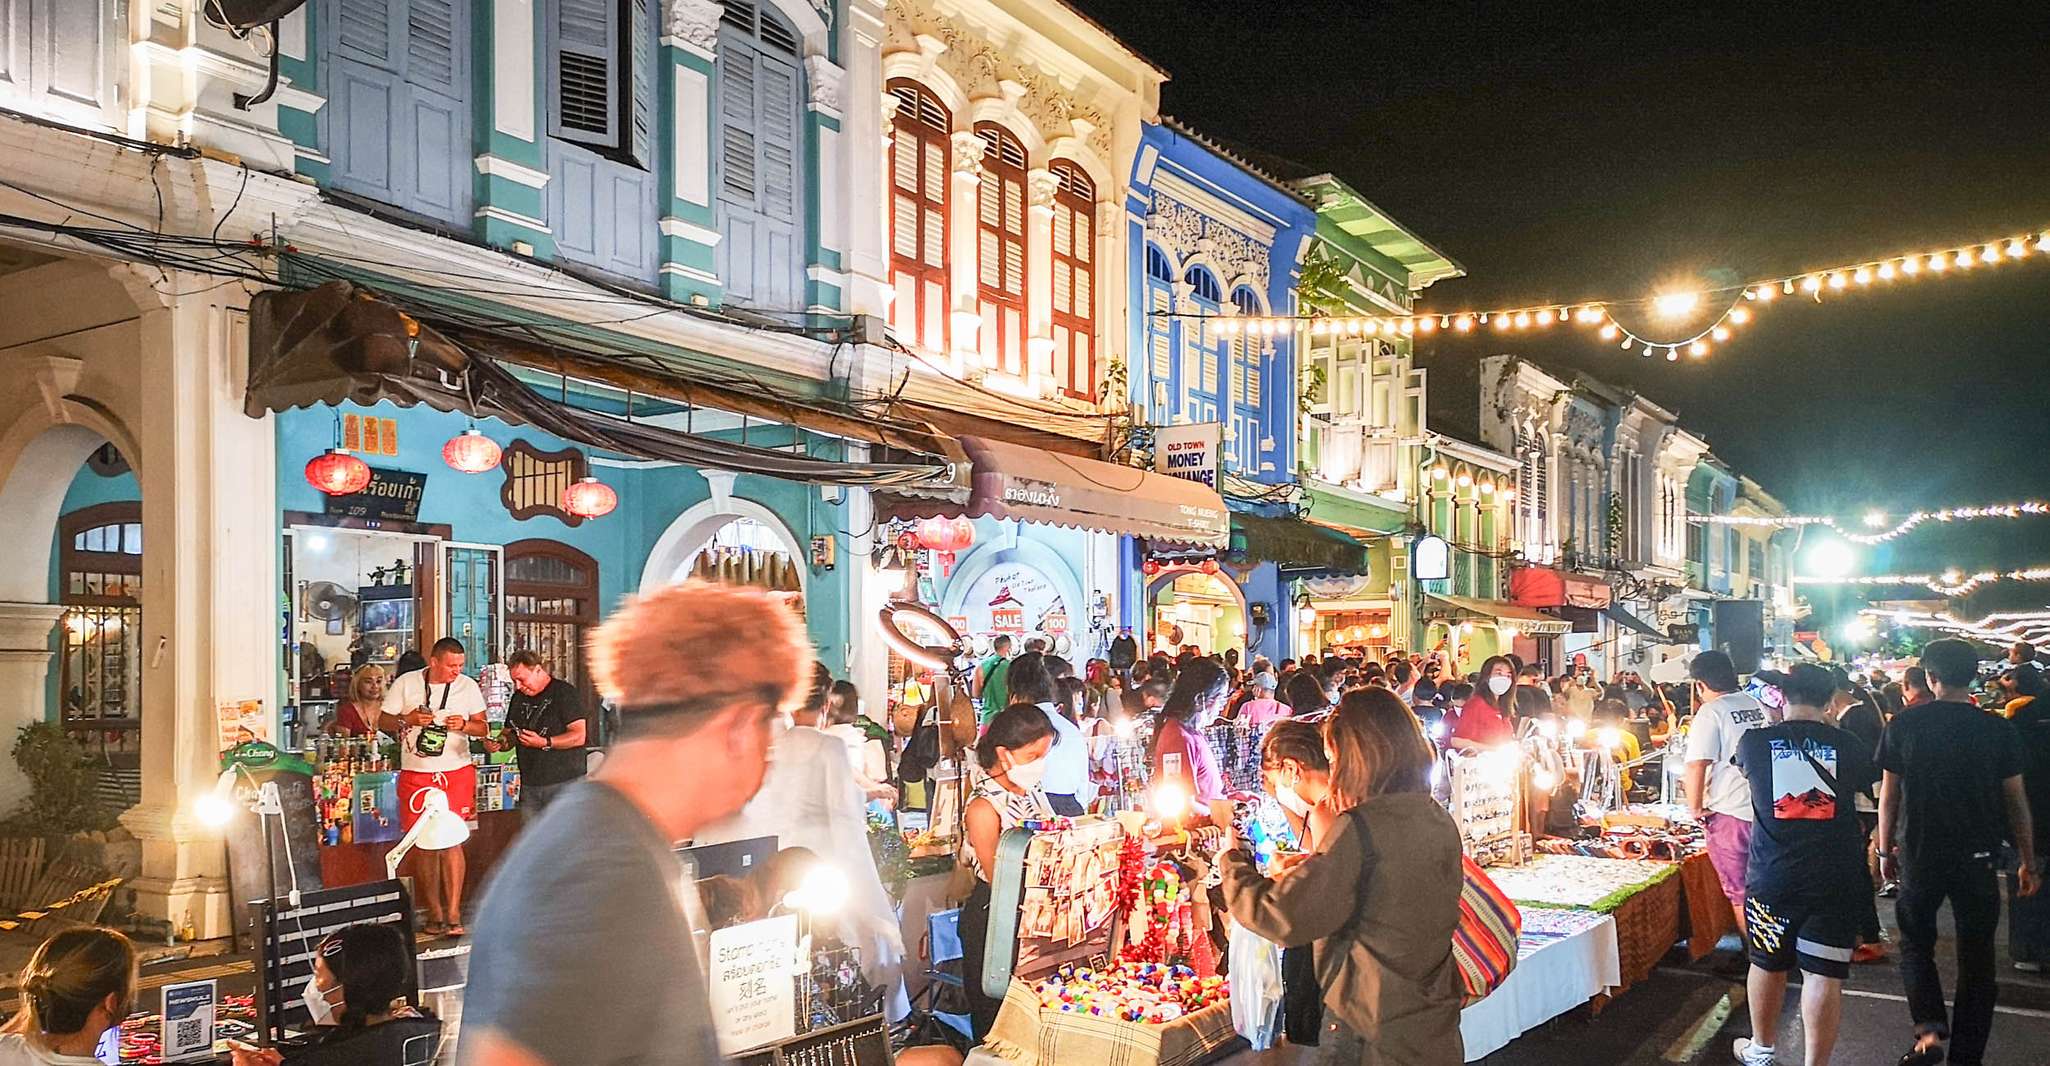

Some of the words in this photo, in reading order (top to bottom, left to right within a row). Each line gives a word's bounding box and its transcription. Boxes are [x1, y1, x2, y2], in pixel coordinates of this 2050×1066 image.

[1168, 443, 1182, 451] OLD
[1184, 440, 1205, 449] TOWN
[1168, 452, 1205, 468] MONEY
[994, 614, 1022, 627] SALE
[1049, 618, 1066, 628] 100
[247, 748, 275, 759] Chang
